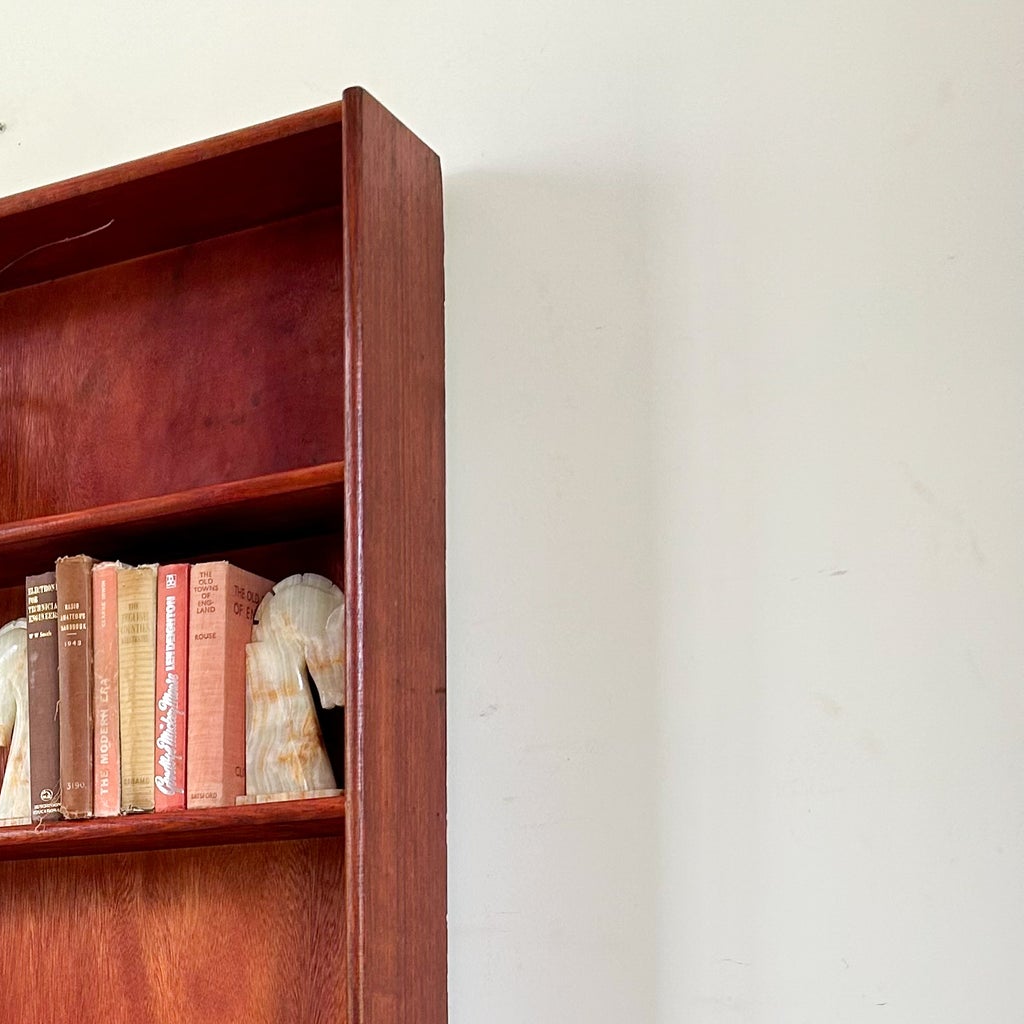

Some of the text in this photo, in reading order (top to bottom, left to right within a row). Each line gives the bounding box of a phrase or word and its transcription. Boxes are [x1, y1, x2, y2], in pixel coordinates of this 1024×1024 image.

[28, 595, 39, 605] FOR
[233, 585, 260, 604] THE OLD
[64, 602, 80, 611] RADIO
[196, 606, 216, 615] LAND
[233, 602, 244, 616] OF
[165, 595, 176, 651] DEIGHTON
[194, 632, 217, 641] ROUSE
[165, 651, 176, 672] LEN
[158, 672, 179, 711] Mouse
[99, 678, 110, 796] THE MODERN ERA
[156, 709, 185, 750] Mickey
[190, 791, 218, 800] BATSFORD
